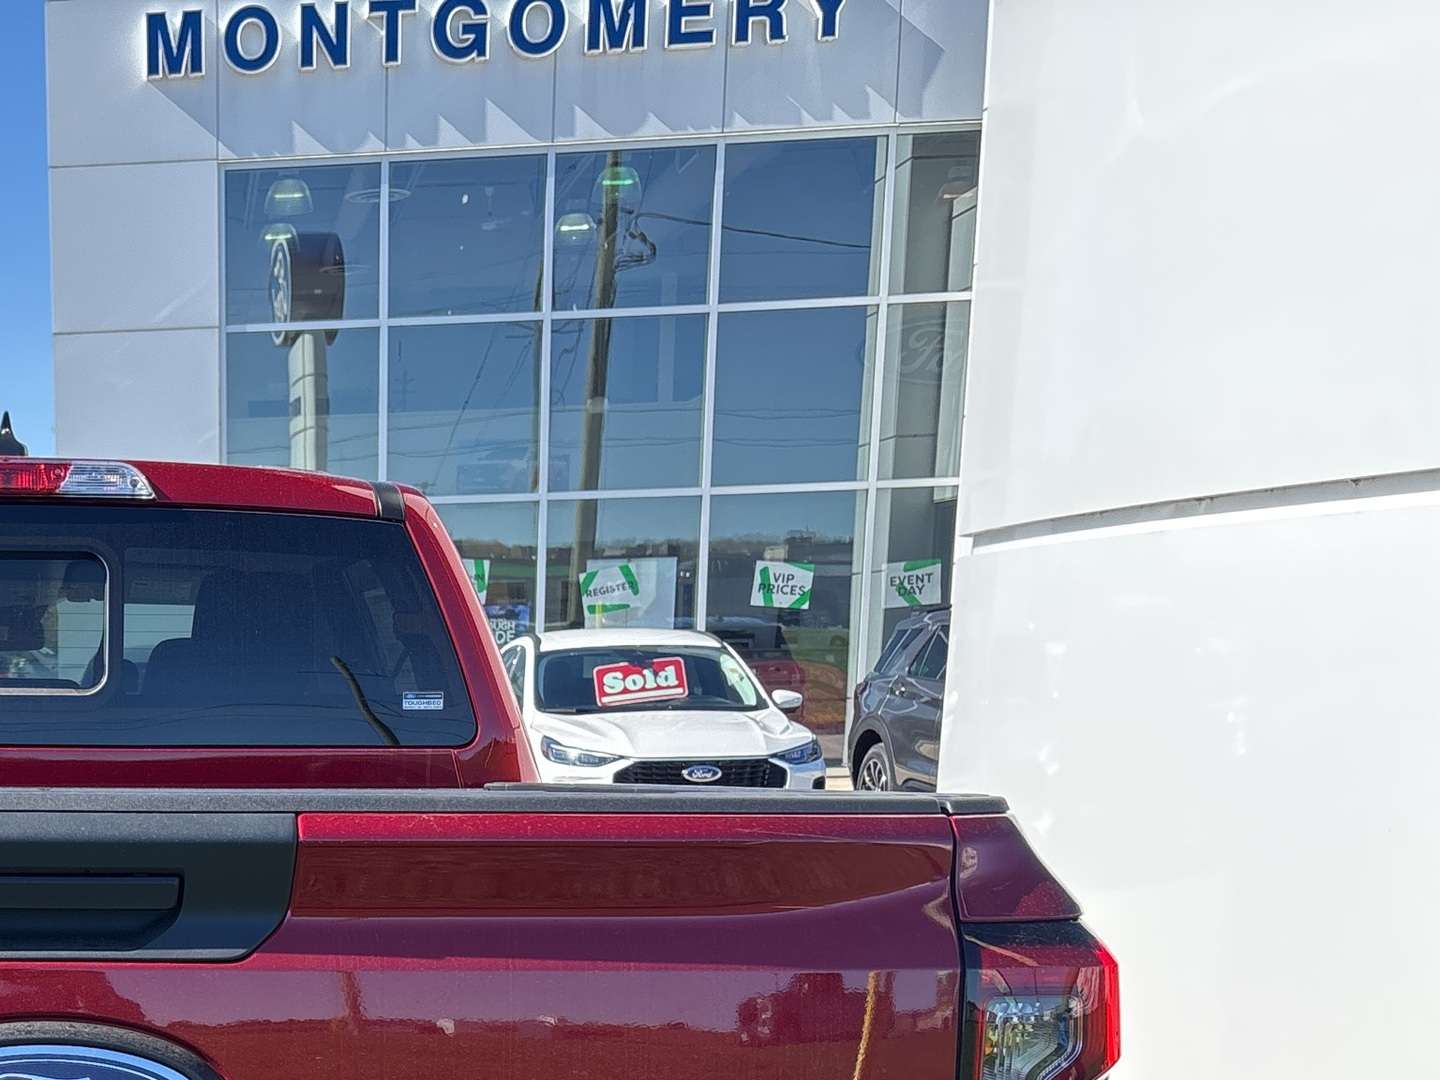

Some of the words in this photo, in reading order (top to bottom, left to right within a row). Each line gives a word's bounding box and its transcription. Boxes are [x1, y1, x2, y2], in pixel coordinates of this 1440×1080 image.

[145, 0, 846, 79] MONTGOMERY
[773, 572, 795, 585] VIP
[890, 572, 934, 587] EVENT
[585, 581, 635, 598] REGISTER
[758, 583, 807, 597] PRICES
[898, 584, 926, 598] DAY
[603, 665, 679, 694] Sold
